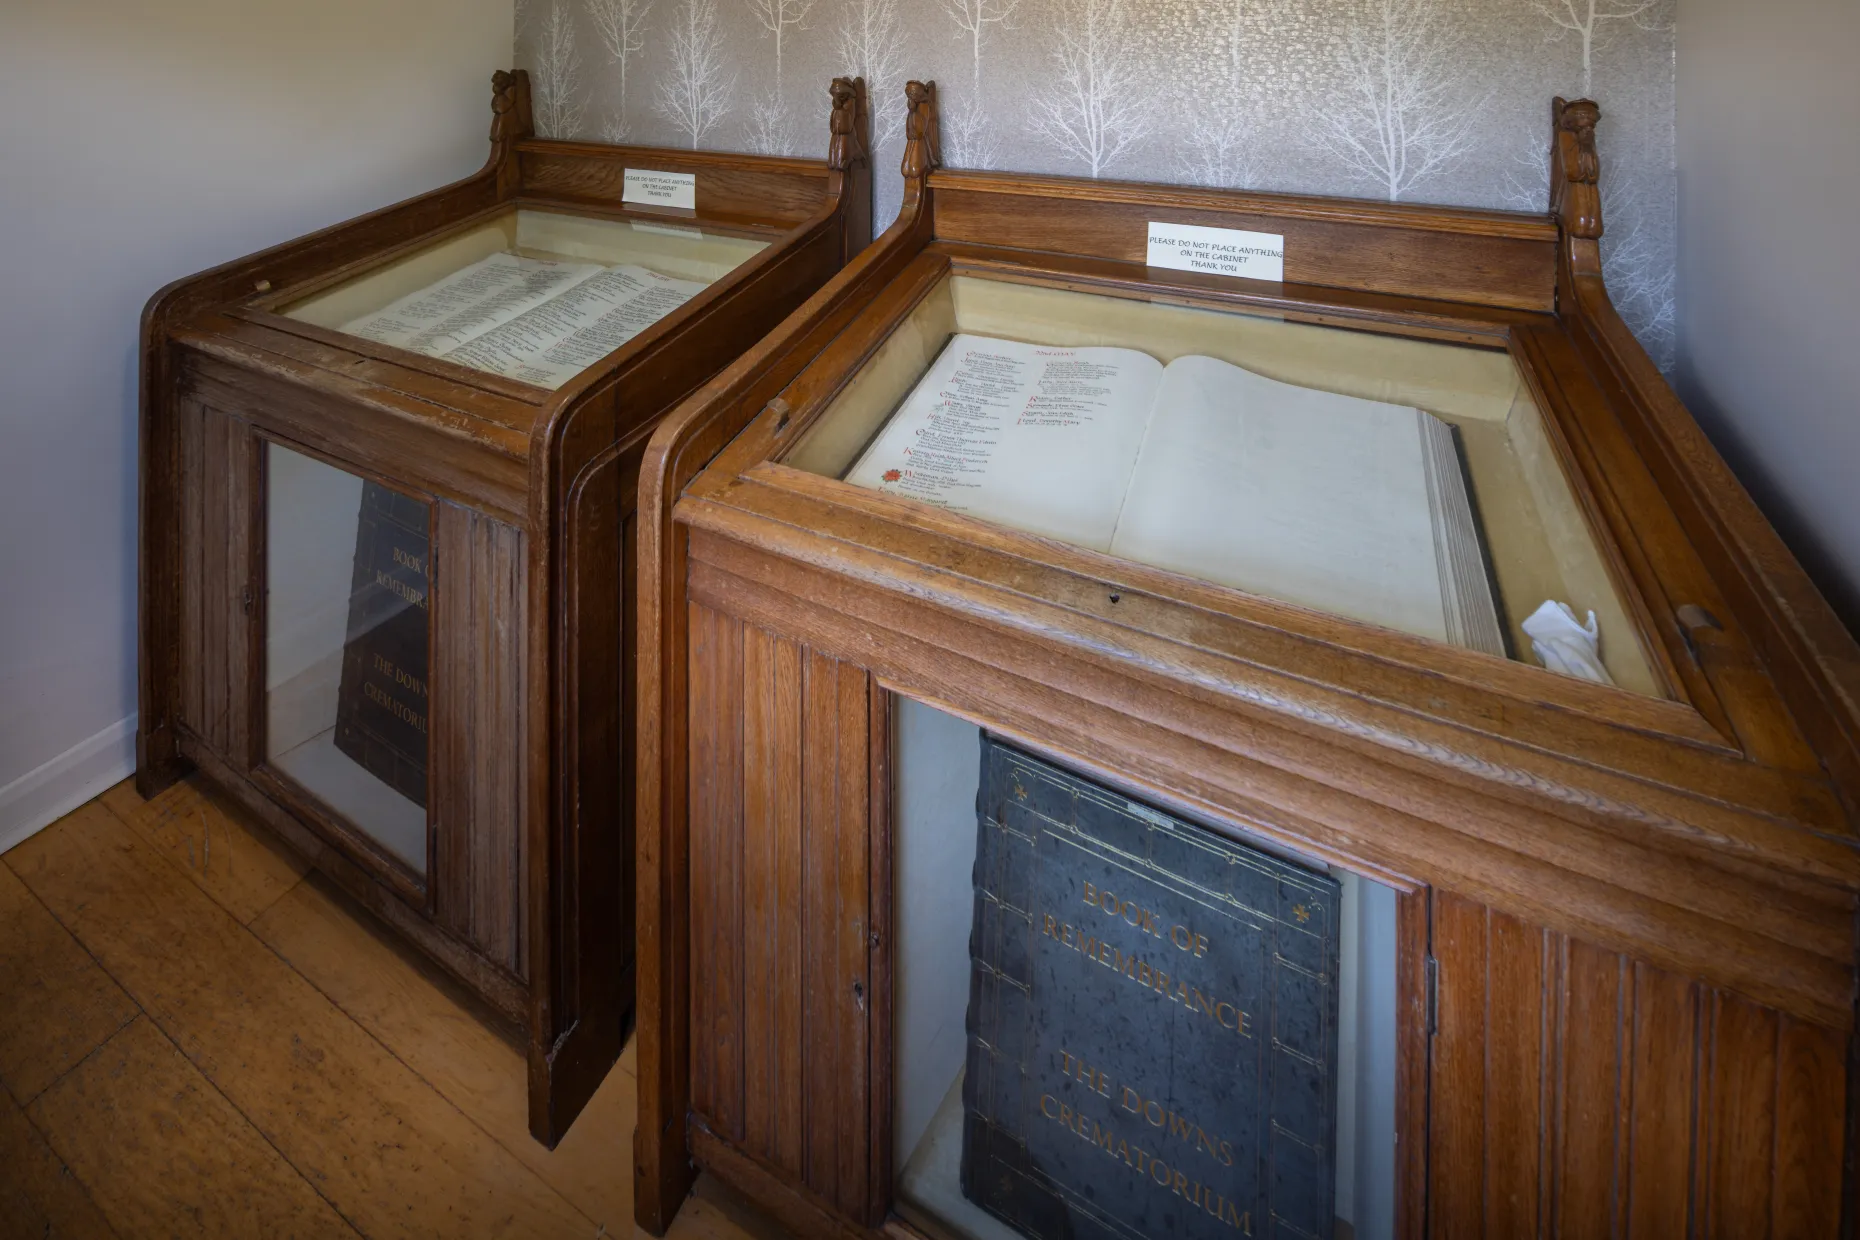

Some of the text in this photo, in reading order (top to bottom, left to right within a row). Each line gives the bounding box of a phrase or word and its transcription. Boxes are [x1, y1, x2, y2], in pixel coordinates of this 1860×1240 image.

[1149, 236, 1176, 246] PLEASE
[1192, 241, 1210, 250] NOT
[1211, 244, 1237, 253] PLACE
[1239, 247, 1283, 259] ANYTHING
[1195, 251, 1210, 259] THE
[1212, 253, 1249, 264] CABINET
[1190, 260, 1237, 272] THANK YOU
[393, 546, 422, 574] BOOK
[374, 652, 393, 677] THE
[1082, 880, 1210, 960] BOOK OF
[1042, 912, 1252, 1040] REMEMBRANCE
[1059, 1049, 1235, 1169] THE DOWNS
[1039, 1093, 1252, 1238] CREMATORIUM
